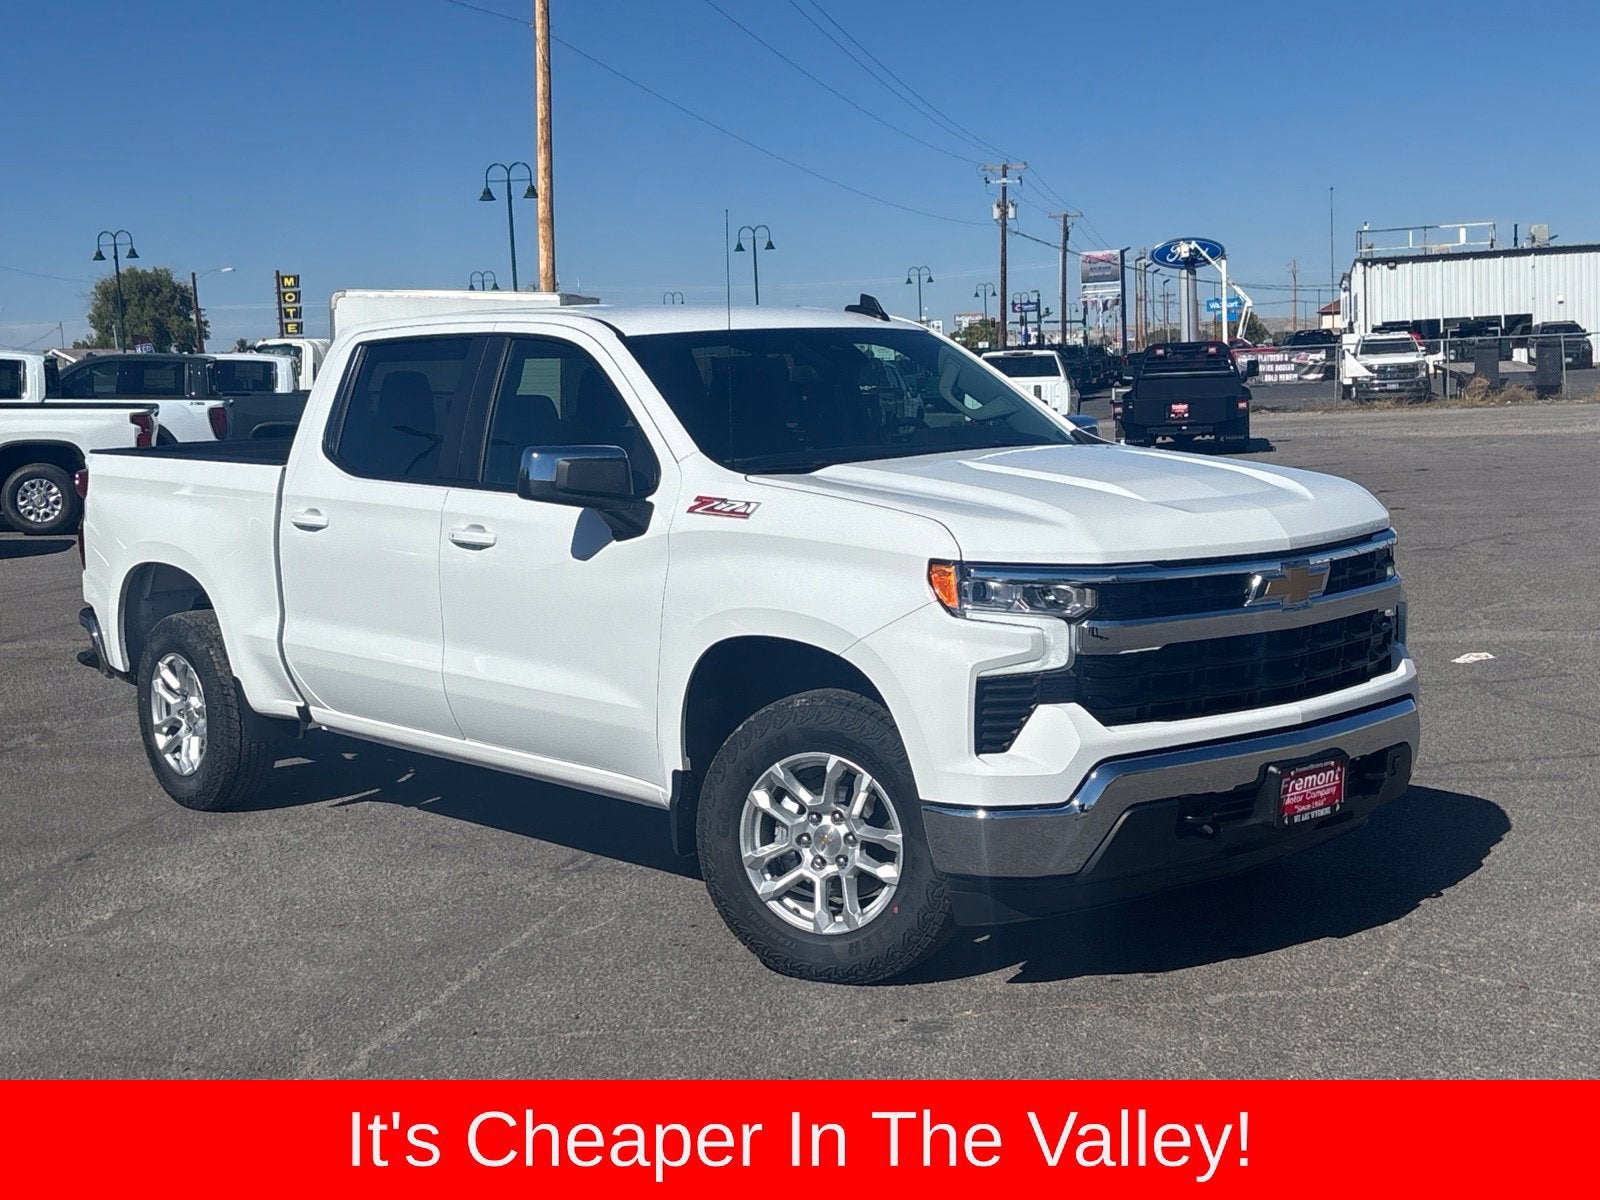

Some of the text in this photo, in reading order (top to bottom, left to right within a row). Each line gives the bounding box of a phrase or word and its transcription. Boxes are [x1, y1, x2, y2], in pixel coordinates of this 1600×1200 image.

[283, 276, 299, 333] MOTE
[686, 495, 762, 519] Z71
[1280, 766, 1341, 795] Fremont
[1282, 785, 1337, 806] Motor Company
[1293, 814, 1302, 823] WE
[1301, 811, 1310, 821] ARE
